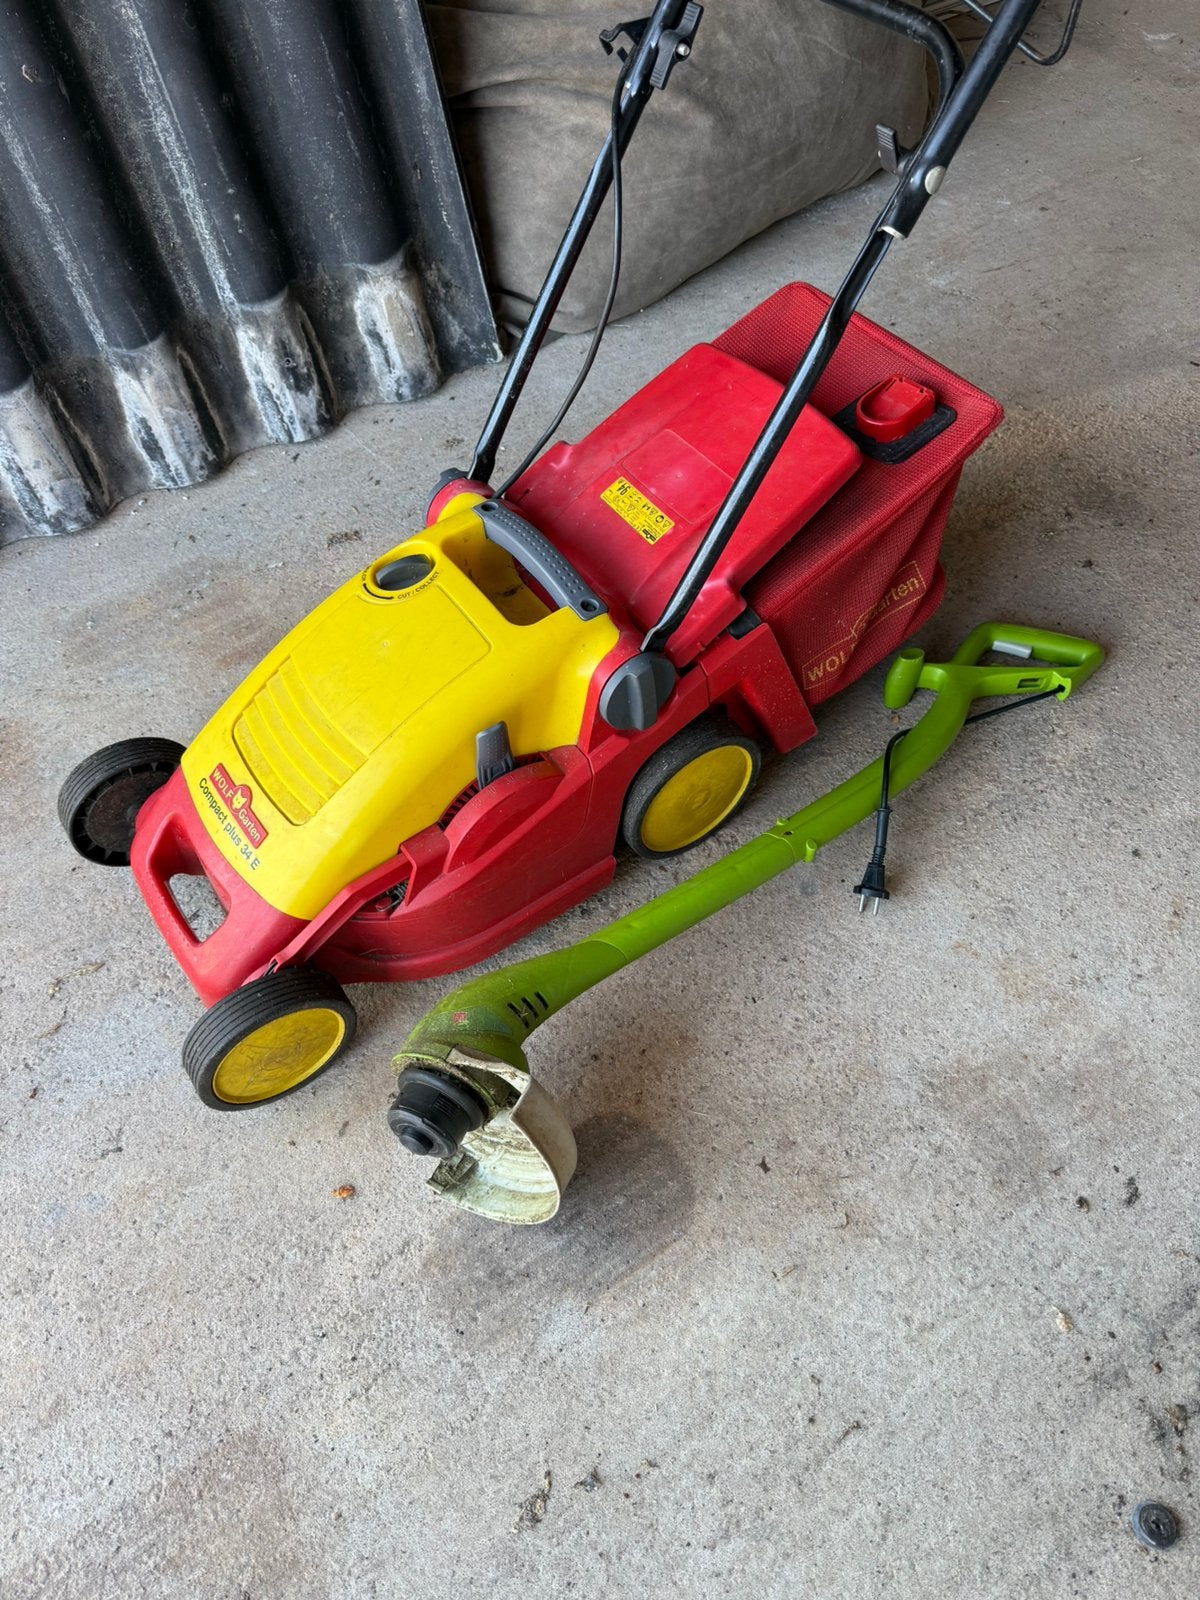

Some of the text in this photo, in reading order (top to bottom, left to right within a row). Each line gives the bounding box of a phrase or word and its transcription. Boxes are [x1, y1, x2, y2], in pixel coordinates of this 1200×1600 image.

[397, 592, 410, 600] CUT
[415, 571, 439, 593] COLLECT
[199, 778, 260, 870] Compact plus 34 E
[213, 768, 261, 842] WOLF Garten
